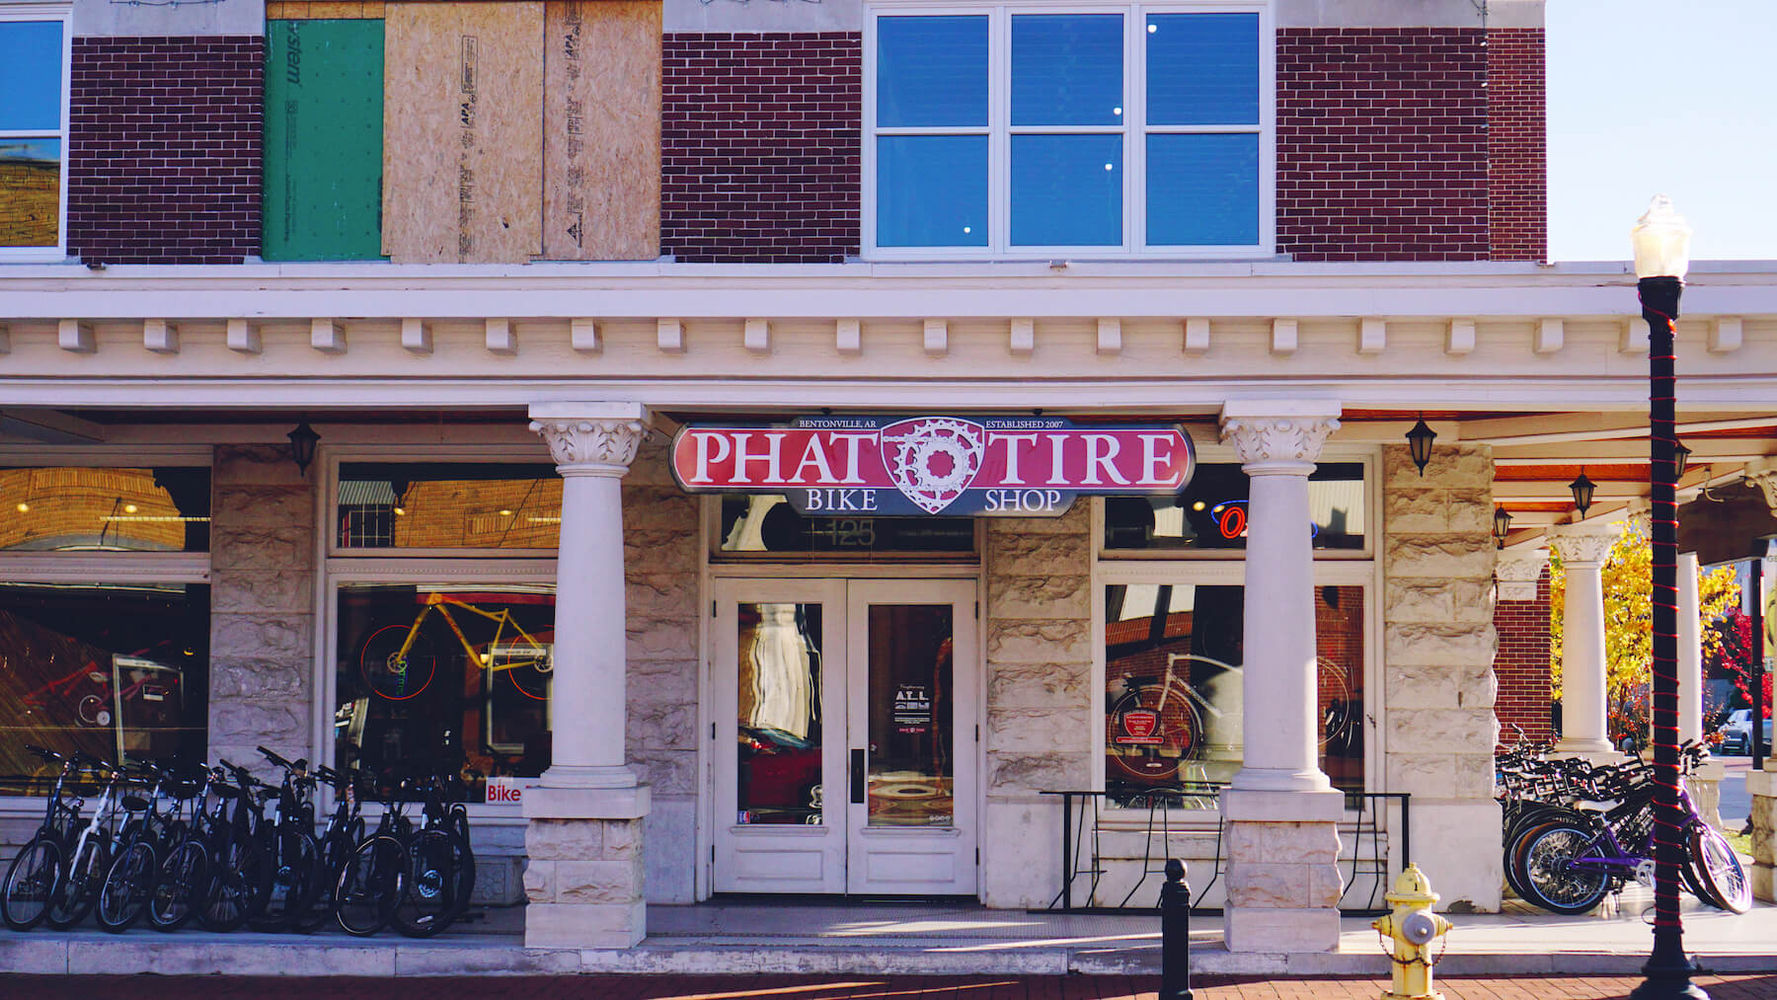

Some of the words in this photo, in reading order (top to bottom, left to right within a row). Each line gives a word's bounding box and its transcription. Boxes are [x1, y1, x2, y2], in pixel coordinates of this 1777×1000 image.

[800, 420, 862, 429] BENTONVILLE,
[864, 420, 877, 428] AR
[985, 420, 1044, 429] ESTABLISHED
[1045, 420, 1064, 429] 2007
[689, 432, 878, 484] PHAT
[987, 432, 1180, 485] TIRE
[805, 488, 878, 511] BIKE
[984, 489, 1061, 512] SHOP
[826, 519, 876, 546] 125
[488, 784, 522, 801] Bike
